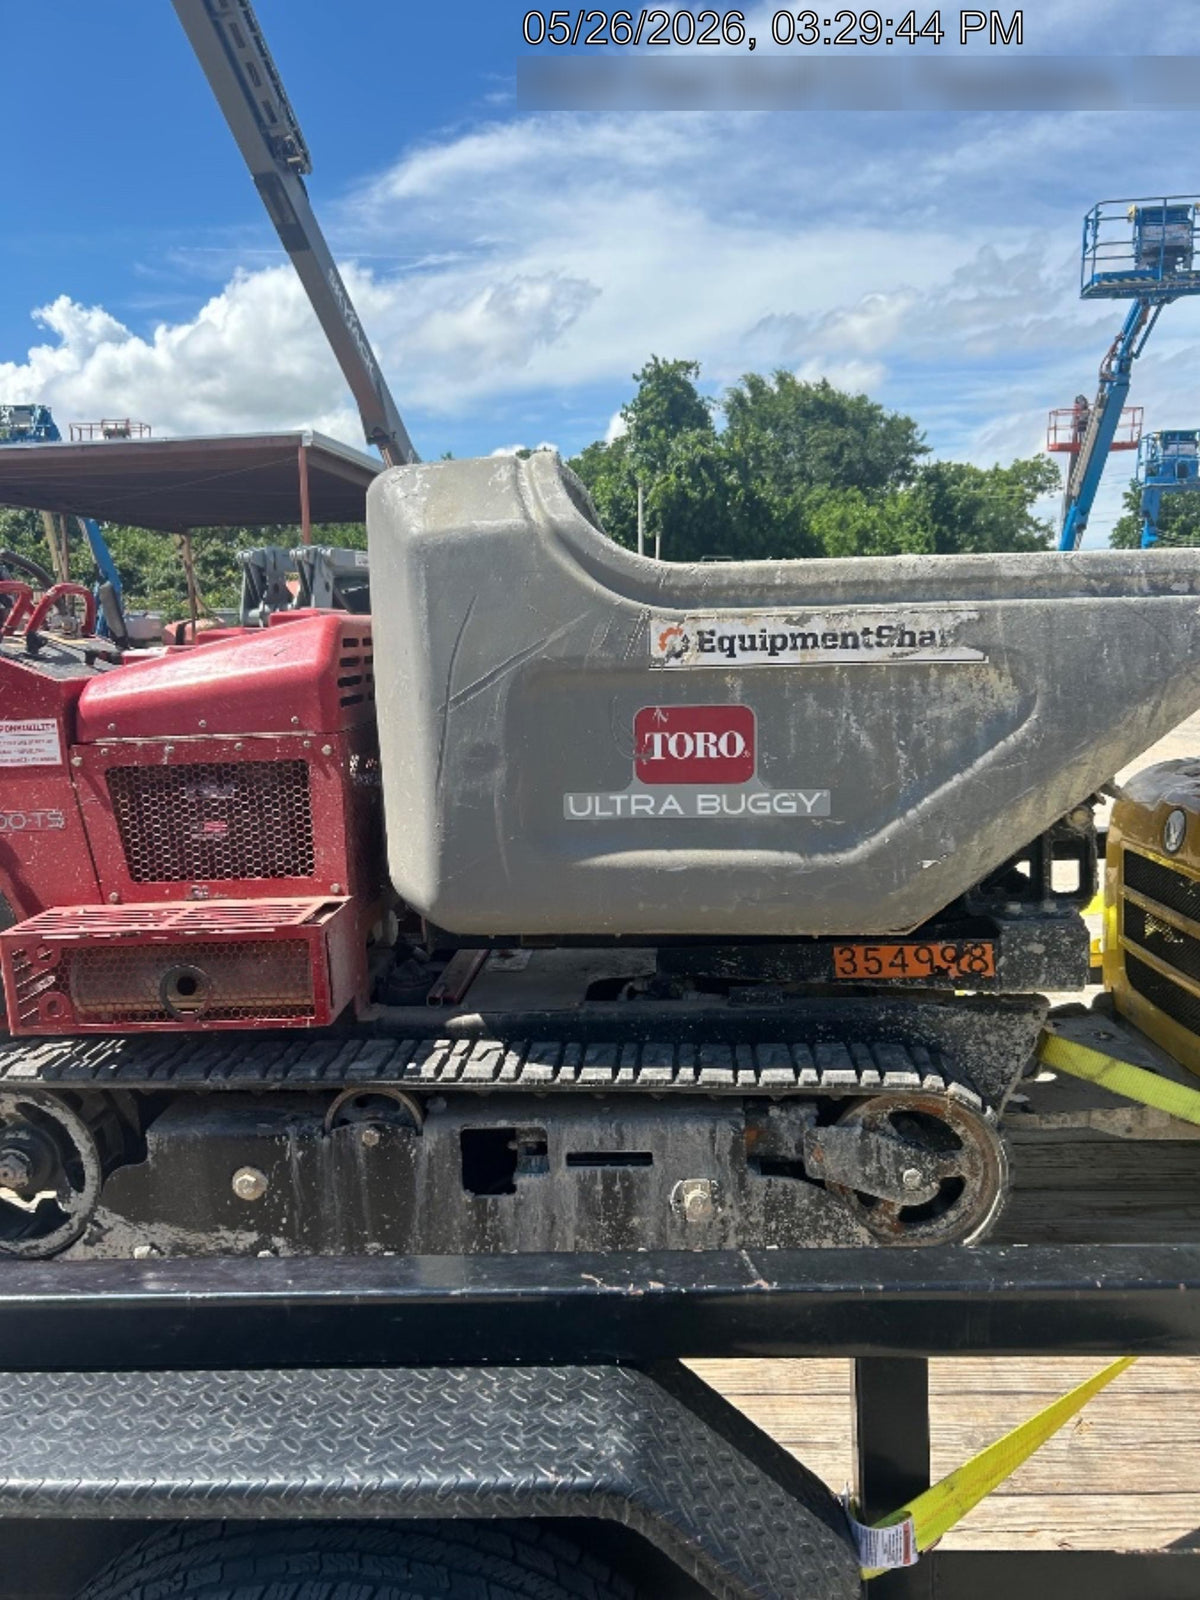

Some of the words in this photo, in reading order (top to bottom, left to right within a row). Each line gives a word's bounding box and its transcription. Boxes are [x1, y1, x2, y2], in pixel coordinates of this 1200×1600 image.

[696, 620, 950, 658] EquipmentSha
[644, 730, 746, 760] TORO
[568, 794, 686, 816] ULTRA
[696, 792, 822, 815] BUGGY
